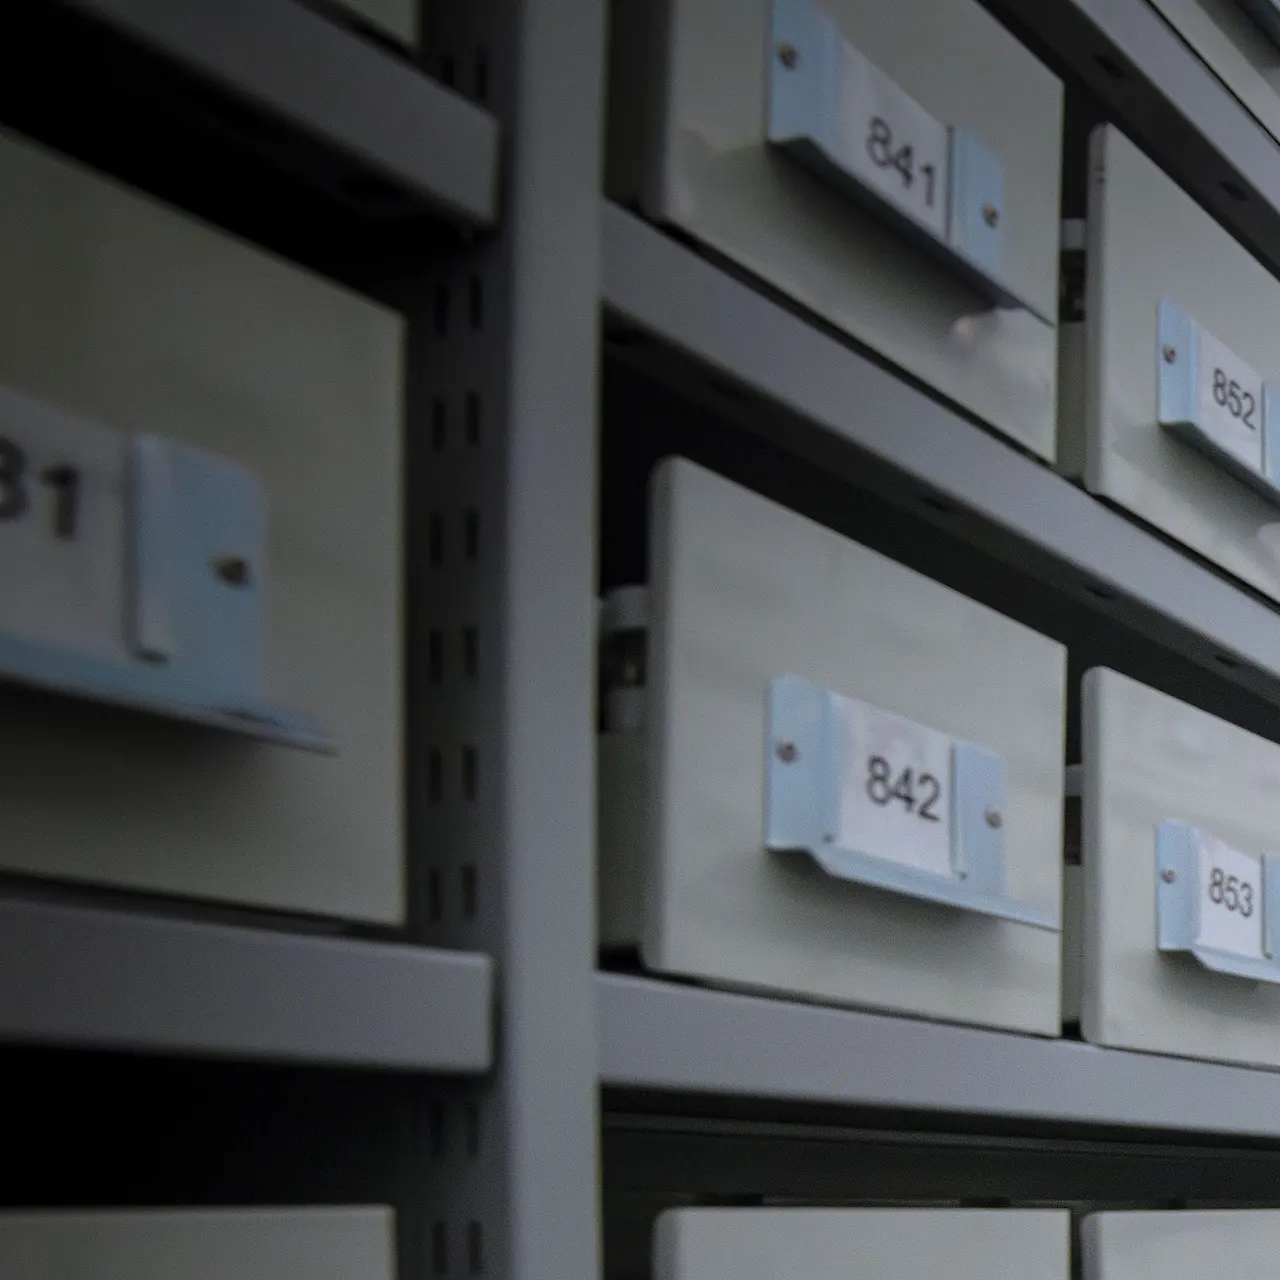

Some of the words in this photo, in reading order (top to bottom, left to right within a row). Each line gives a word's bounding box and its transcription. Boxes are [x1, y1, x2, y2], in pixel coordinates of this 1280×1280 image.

[866, 116, 936, 208] 841
[1212, 369, 1257, 431] 852
[865, 754, 943, 823] 842
[1208, 868, 1255, 918] 853
